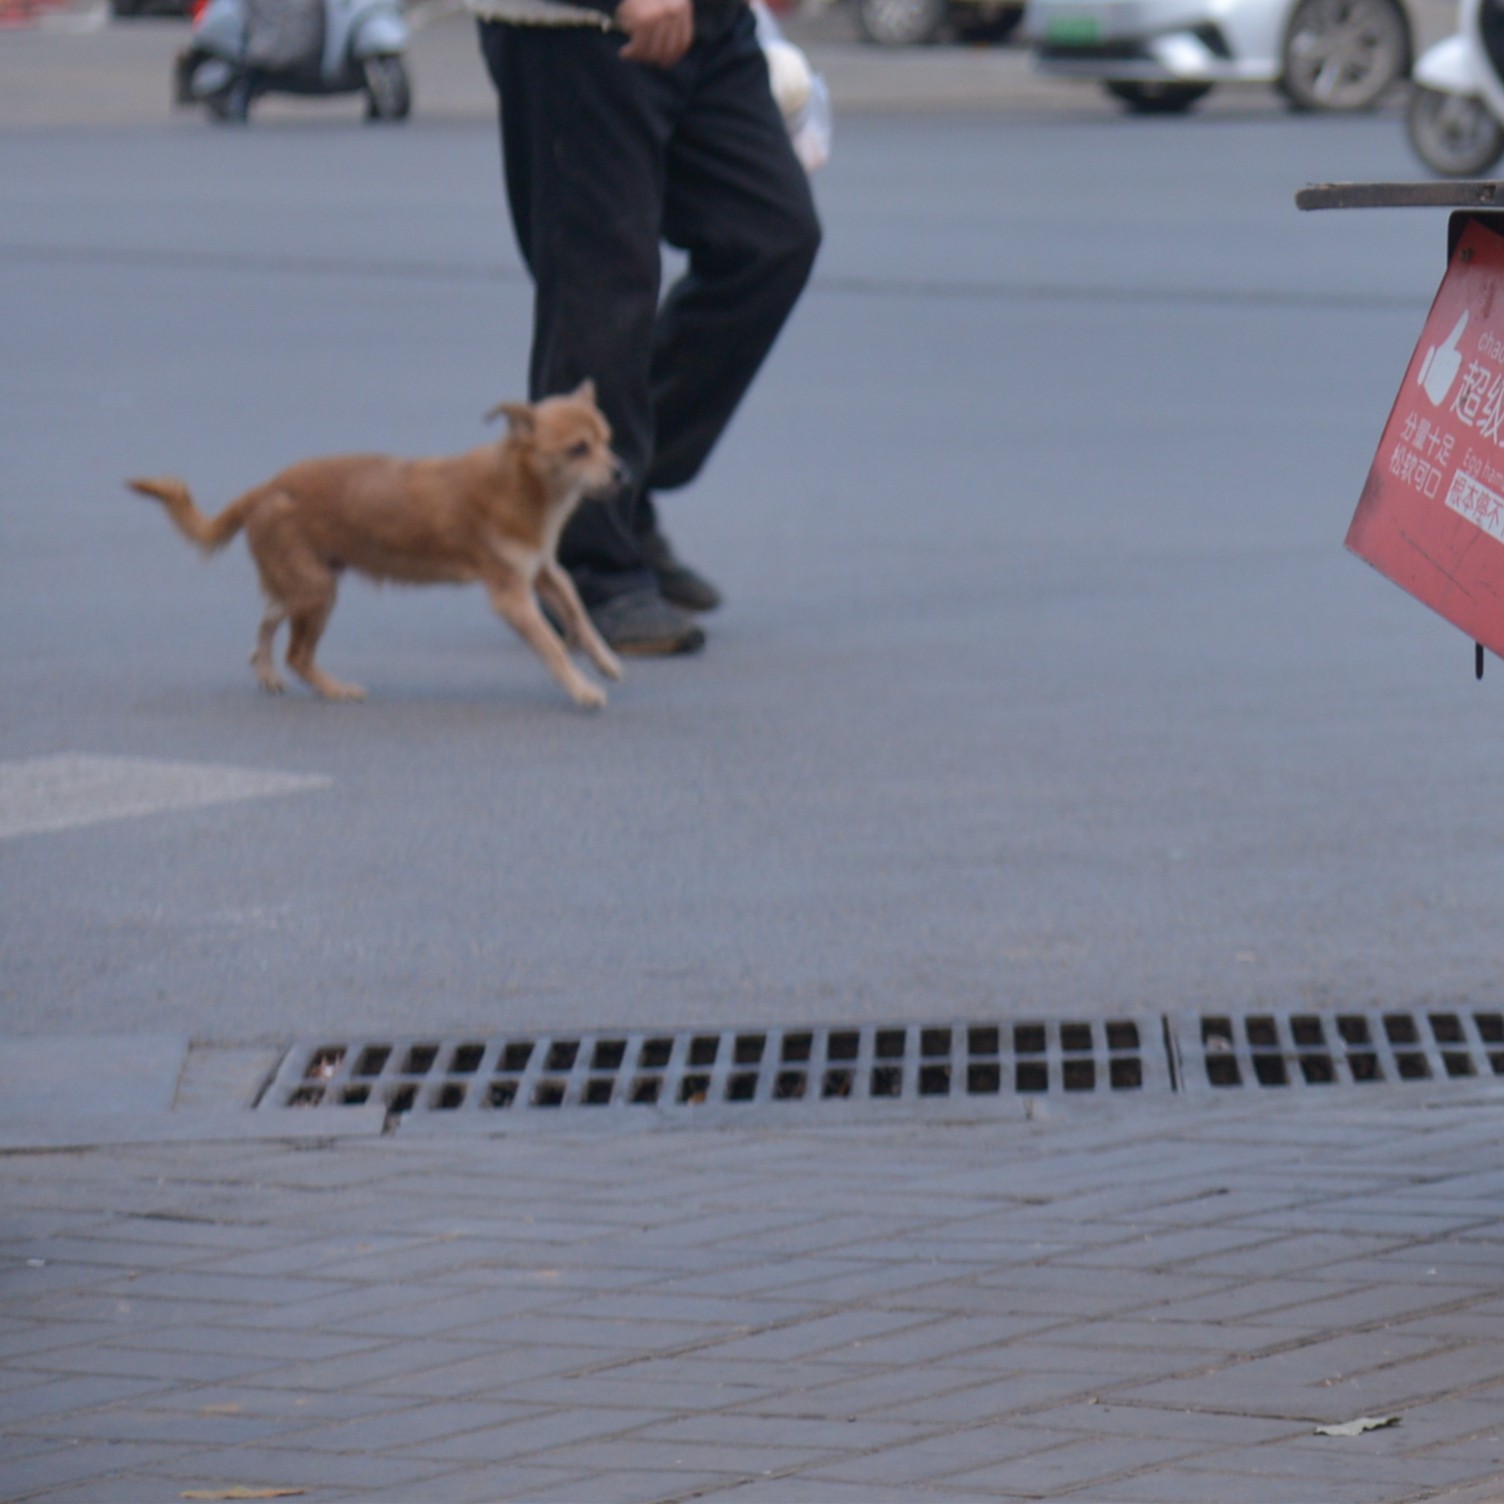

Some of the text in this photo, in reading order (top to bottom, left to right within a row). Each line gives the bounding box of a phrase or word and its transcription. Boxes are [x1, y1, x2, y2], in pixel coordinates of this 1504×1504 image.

[1400, 411, 1455, 467] 分量十足
[1463, 448, 1482, 479] Egg
[1389, 443, 1442, 499] 松软可口
